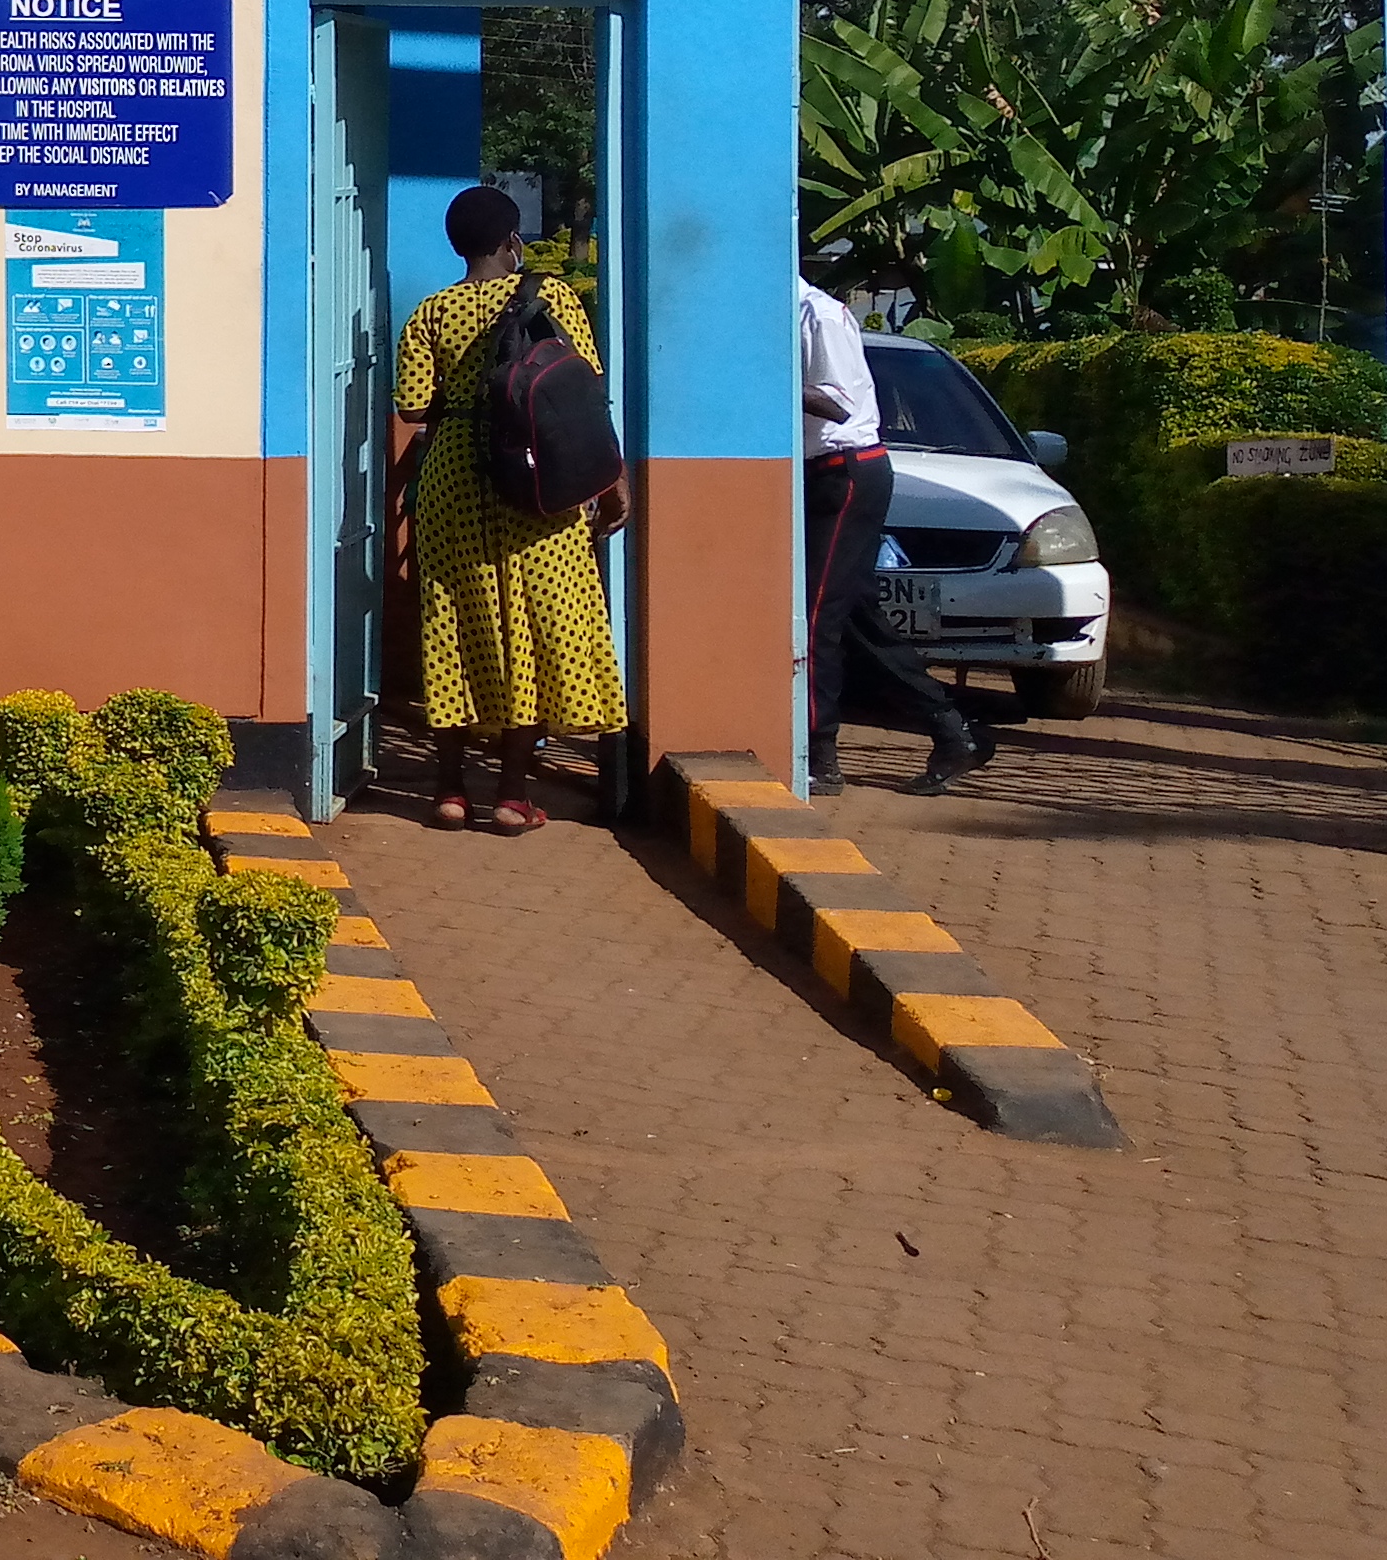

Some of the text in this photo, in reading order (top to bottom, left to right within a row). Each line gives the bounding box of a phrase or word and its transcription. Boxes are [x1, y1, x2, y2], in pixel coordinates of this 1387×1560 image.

[40, 32, 76, 49] RISKS
[79, 32, 153, 51] ASSOCIATED
[157, 34, 187, 51] WITH
[191, 34, 214, 51] THE
[38, 56, 73, 72] VIRUS
[77, 56, 125, 73] SPREAD
[129, 56, 207, 76] WORLDWIDE,
[52, 79, 76, 95] ANY
[80, 79, 135, 96] VISITORS
[139, 80, 156, 96] OR
[160, 80, 225, 97] RELATIVES
[16, 101, 116, 118] IN THE HOSPITAL
[1, 124, 28, 140] TIME
[32, 124, 63, 141] WITH
[66, 124, 132, 141] IMMEDIATE
[136, 126, 178, 142] EFFECT
[18, 147, 41, 163] THE
[45, 148, 88, 164] SOCIAL
[91, 148, 149, 165] DISTANCE
[16, 184, 118, 197] BY MANAGEMENT
[14, 233, 42, 243] Stop
[19, 243, 83, 253] Coronavirus
[1232, 449, 1244, 464] NO
[878, 576, 913, 603] BN
